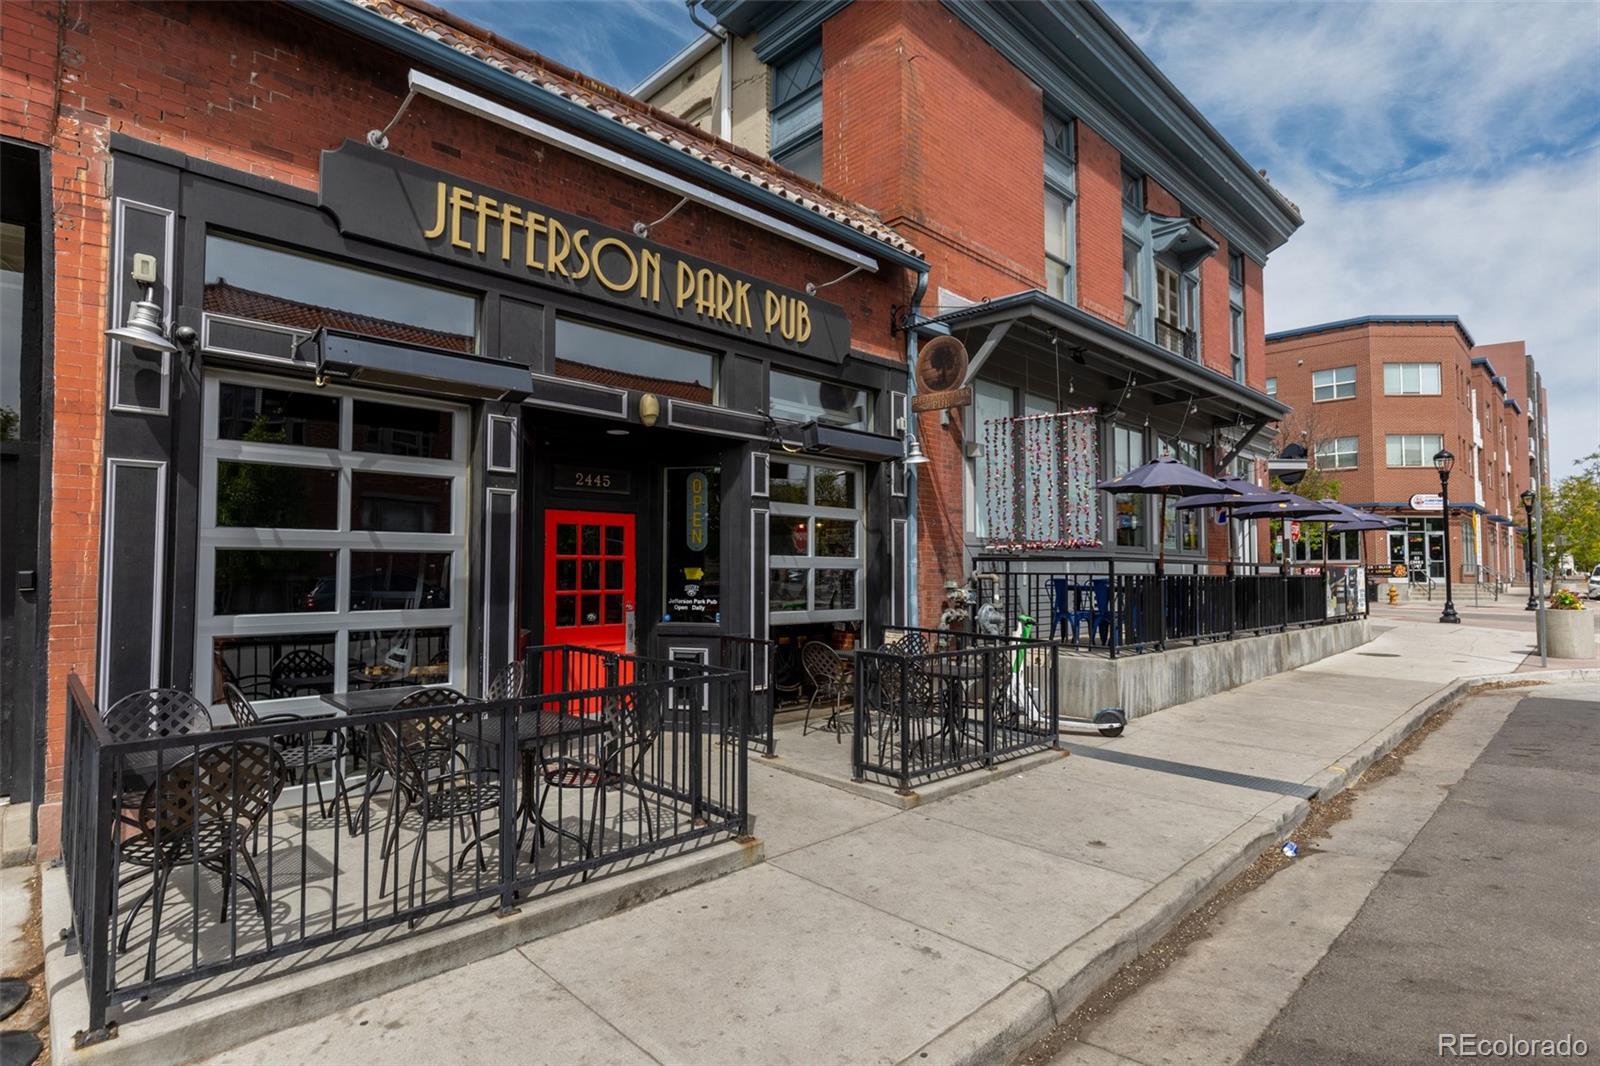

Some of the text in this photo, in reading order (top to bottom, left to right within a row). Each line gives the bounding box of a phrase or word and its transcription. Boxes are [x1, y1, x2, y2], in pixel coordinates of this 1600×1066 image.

[424, 181, 812, 343] JEFFERSON PARK PUB
[575, 472, 611, 487] 2445
[691, 478, 703, 545] OPEN
